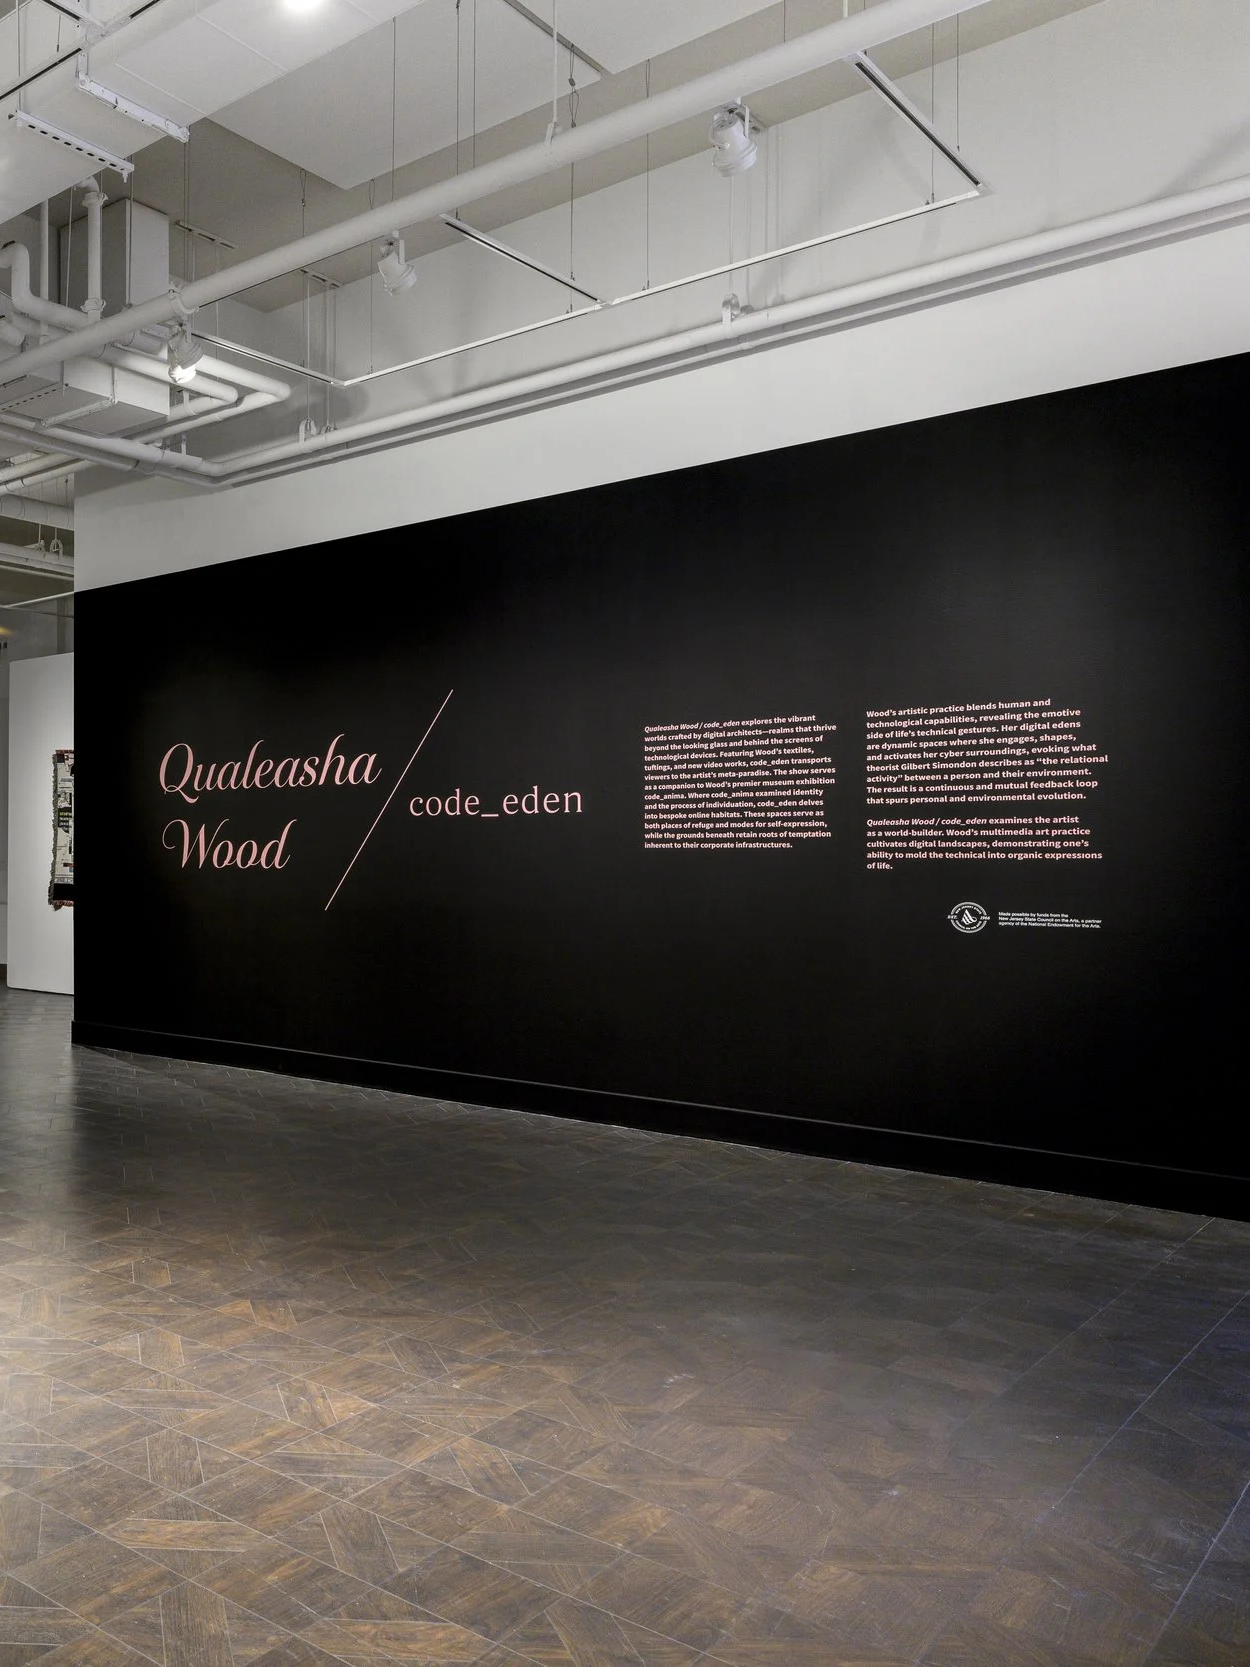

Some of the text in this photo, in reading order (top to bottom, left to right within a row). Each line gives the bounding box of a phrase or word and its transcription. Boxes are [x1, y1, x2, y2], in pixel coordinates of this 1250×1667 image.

[898, 707, 928, 715] artistic
[929, 705, 965, 714] practice
[644, 725, 679, 733] Qualeasha
[703, 720, 740, 728] code_eden
[741, 718, 772, 726] explores
[866, 718, 923, 728] technological
[924, 716, 978, 725] capabilities,
[979, 713, 1022, 721] revealing
[1041, 709, 1081, 717] emotive
[702, 731, 726, 739] digital
[916, 728, 957, 736] technical
[958, 727, 999, 736] gestures.
[1019, 722, 1050, 732] digital
[644, 744, 669, 752] beyond
[744, 738, 769, 746] behind
[881, 741, 917, 750] dynamic
[996, 736, 1038, 744] engages,
[1039, 734, 1076, 742] shapes,
[644, 753, 689, 761] technological
[939, 750, 964, 759] cyber
[966, 748, 1030, 756] surroundings,
[1031, 745, 1070, 753] evoking
[159, 734, 382, 803] Qualeasha
[749, 758, 790, 766] code_eden
[932, 761, 977, 769] Simondon
[978, 759, 1022, 767] describes
[1060, 755, 1108, 764] relational
[718, 770, 772, 778] meta-paradise.
[1026, 769, 1092, 777] environment.
[792, 788, 824, 796] identity
[910, 796, 948, 804] personal
[967, 793, 1035, 801] environmental
[1037, 792, 1086, 800] evolution.
[410, 785, 583, 818] code_eden
[162, 819, 297, 869] Wood
[908, 840, 936, 848] digital
[938, 840, 990, 848] landscapes,
[992, 840, 1061, 848] demonstrating
